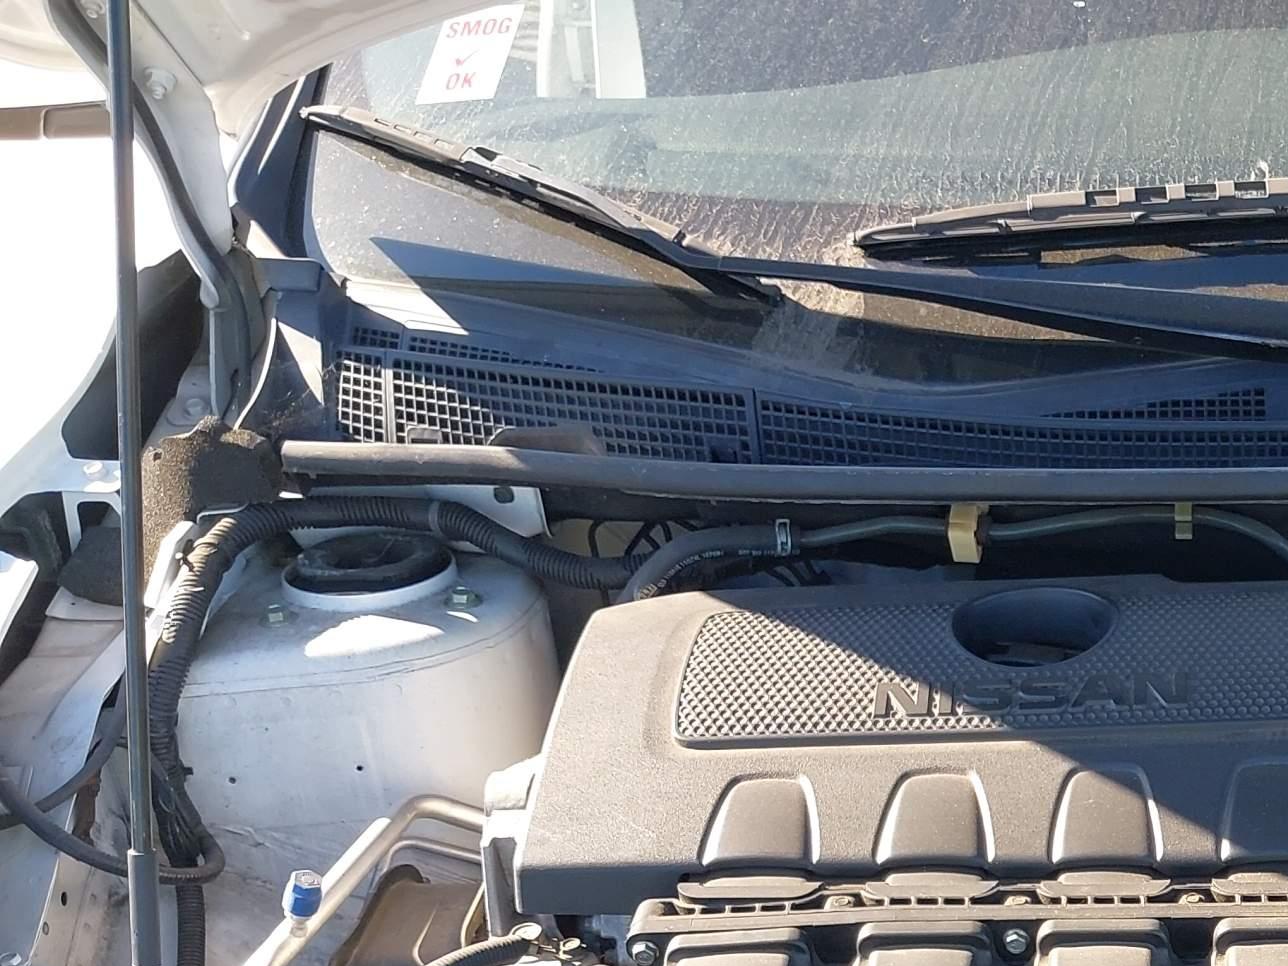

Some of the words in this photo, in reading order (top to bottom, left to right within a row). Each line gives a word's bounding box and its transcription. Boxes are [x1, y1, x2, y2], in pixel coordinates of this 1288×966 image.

[446, 17, 514, 39] SMOG
[445, 71, 477, 91] OK
[872, 672, 1191, 719] NISSAN
